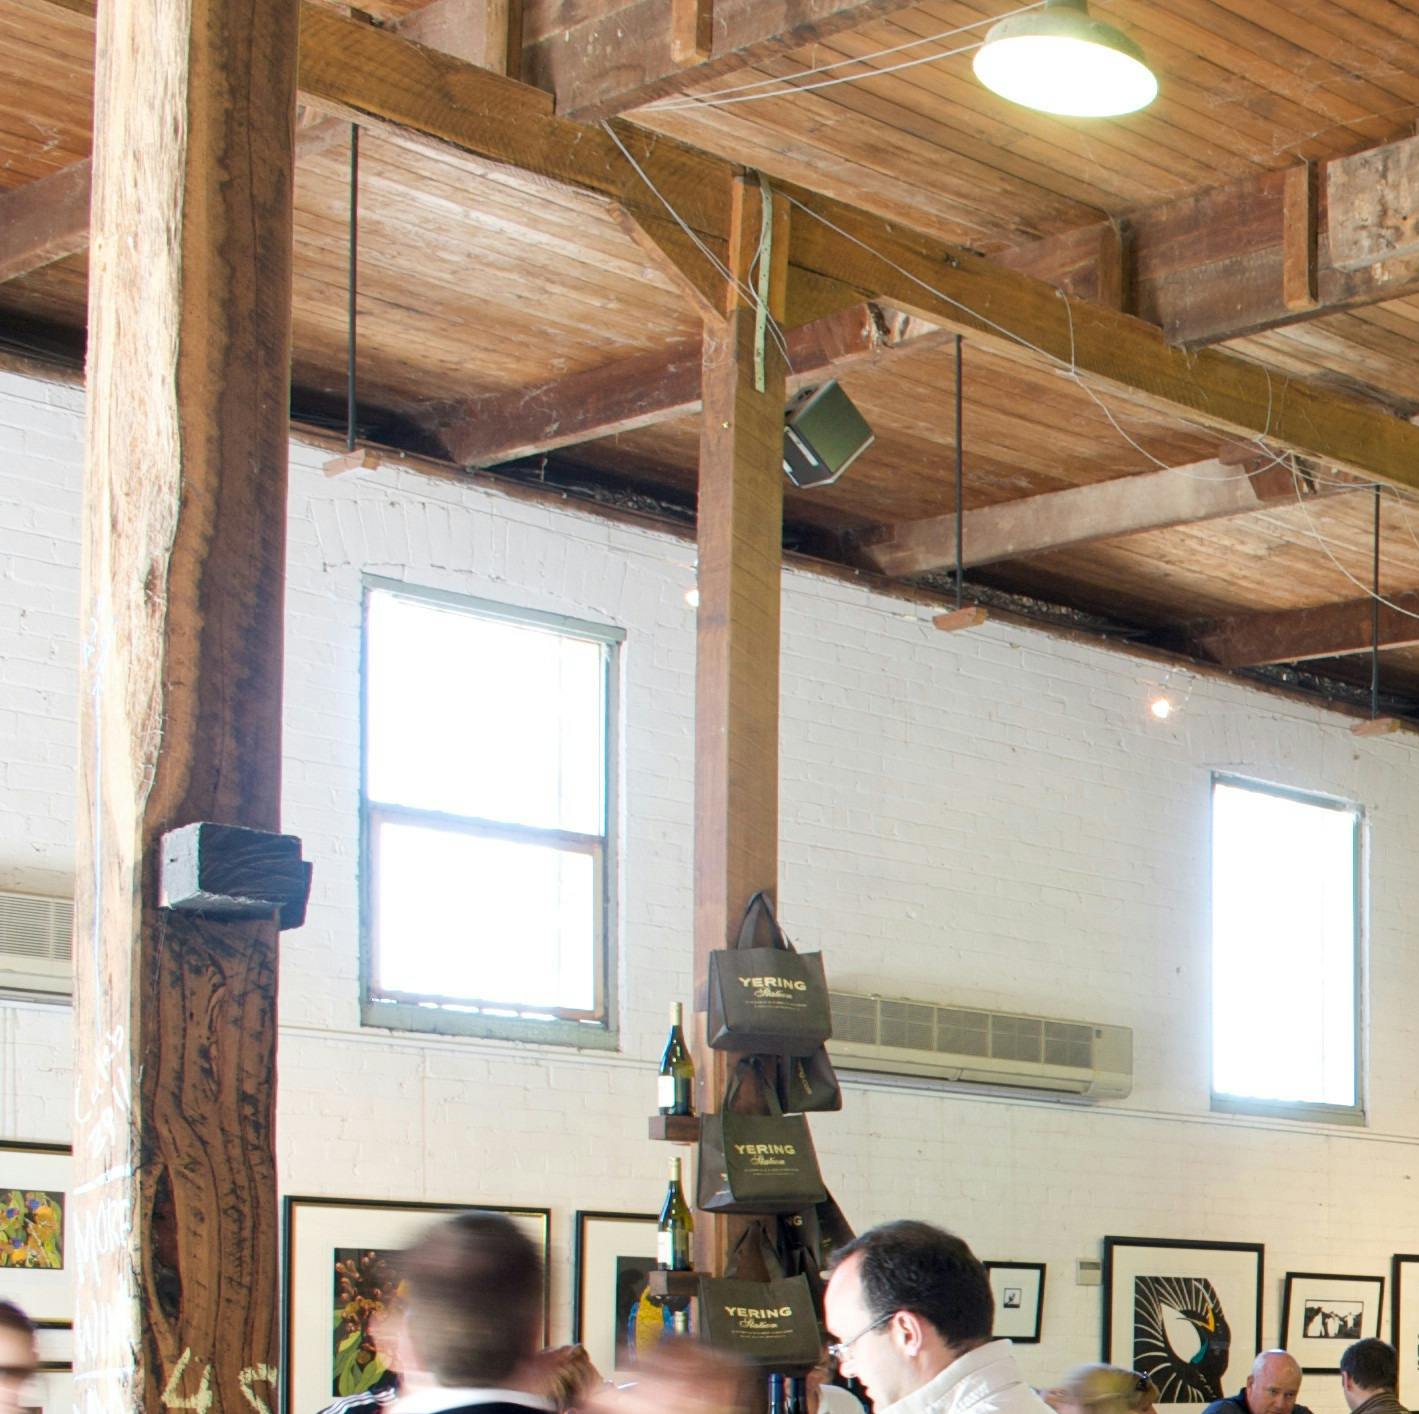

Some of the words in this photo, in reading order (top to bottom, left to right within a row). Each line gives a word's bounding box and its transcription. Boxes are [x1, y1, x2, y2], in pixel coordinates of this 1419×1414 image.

[738, 976, 808, 991] YERING
[734, 1143, 796, 1155] YERING
[724, 1305, 793, 1319] YERING
